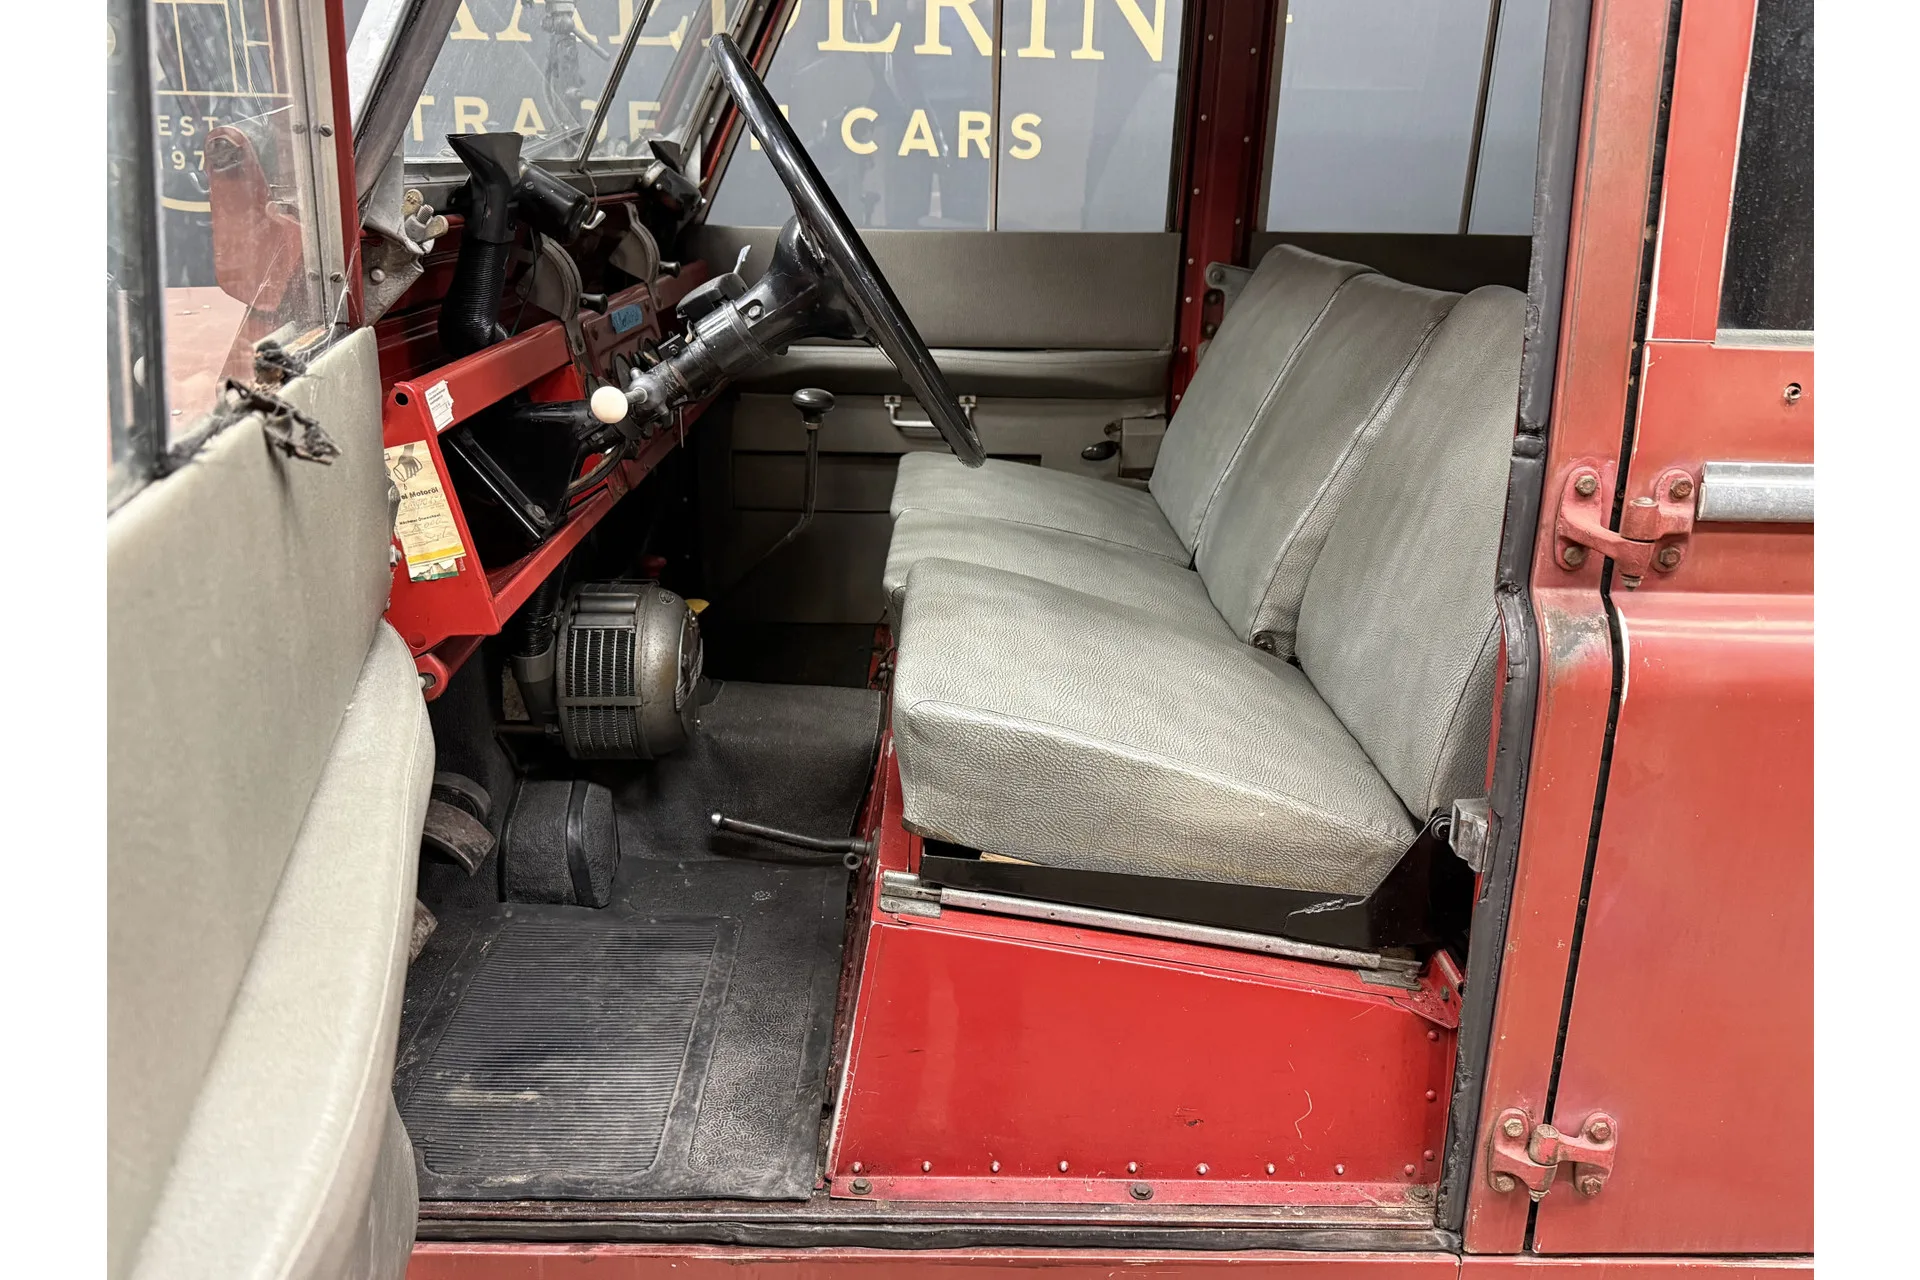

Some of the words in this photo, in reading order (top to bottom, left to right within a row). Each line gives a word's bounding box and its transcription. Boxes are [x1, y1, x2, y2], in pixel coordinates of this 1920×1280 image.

[157, 115, 218, 136] EST
[841, 107, 1043, 159] CARS
[409, 486, 439, 499] Motoröl
